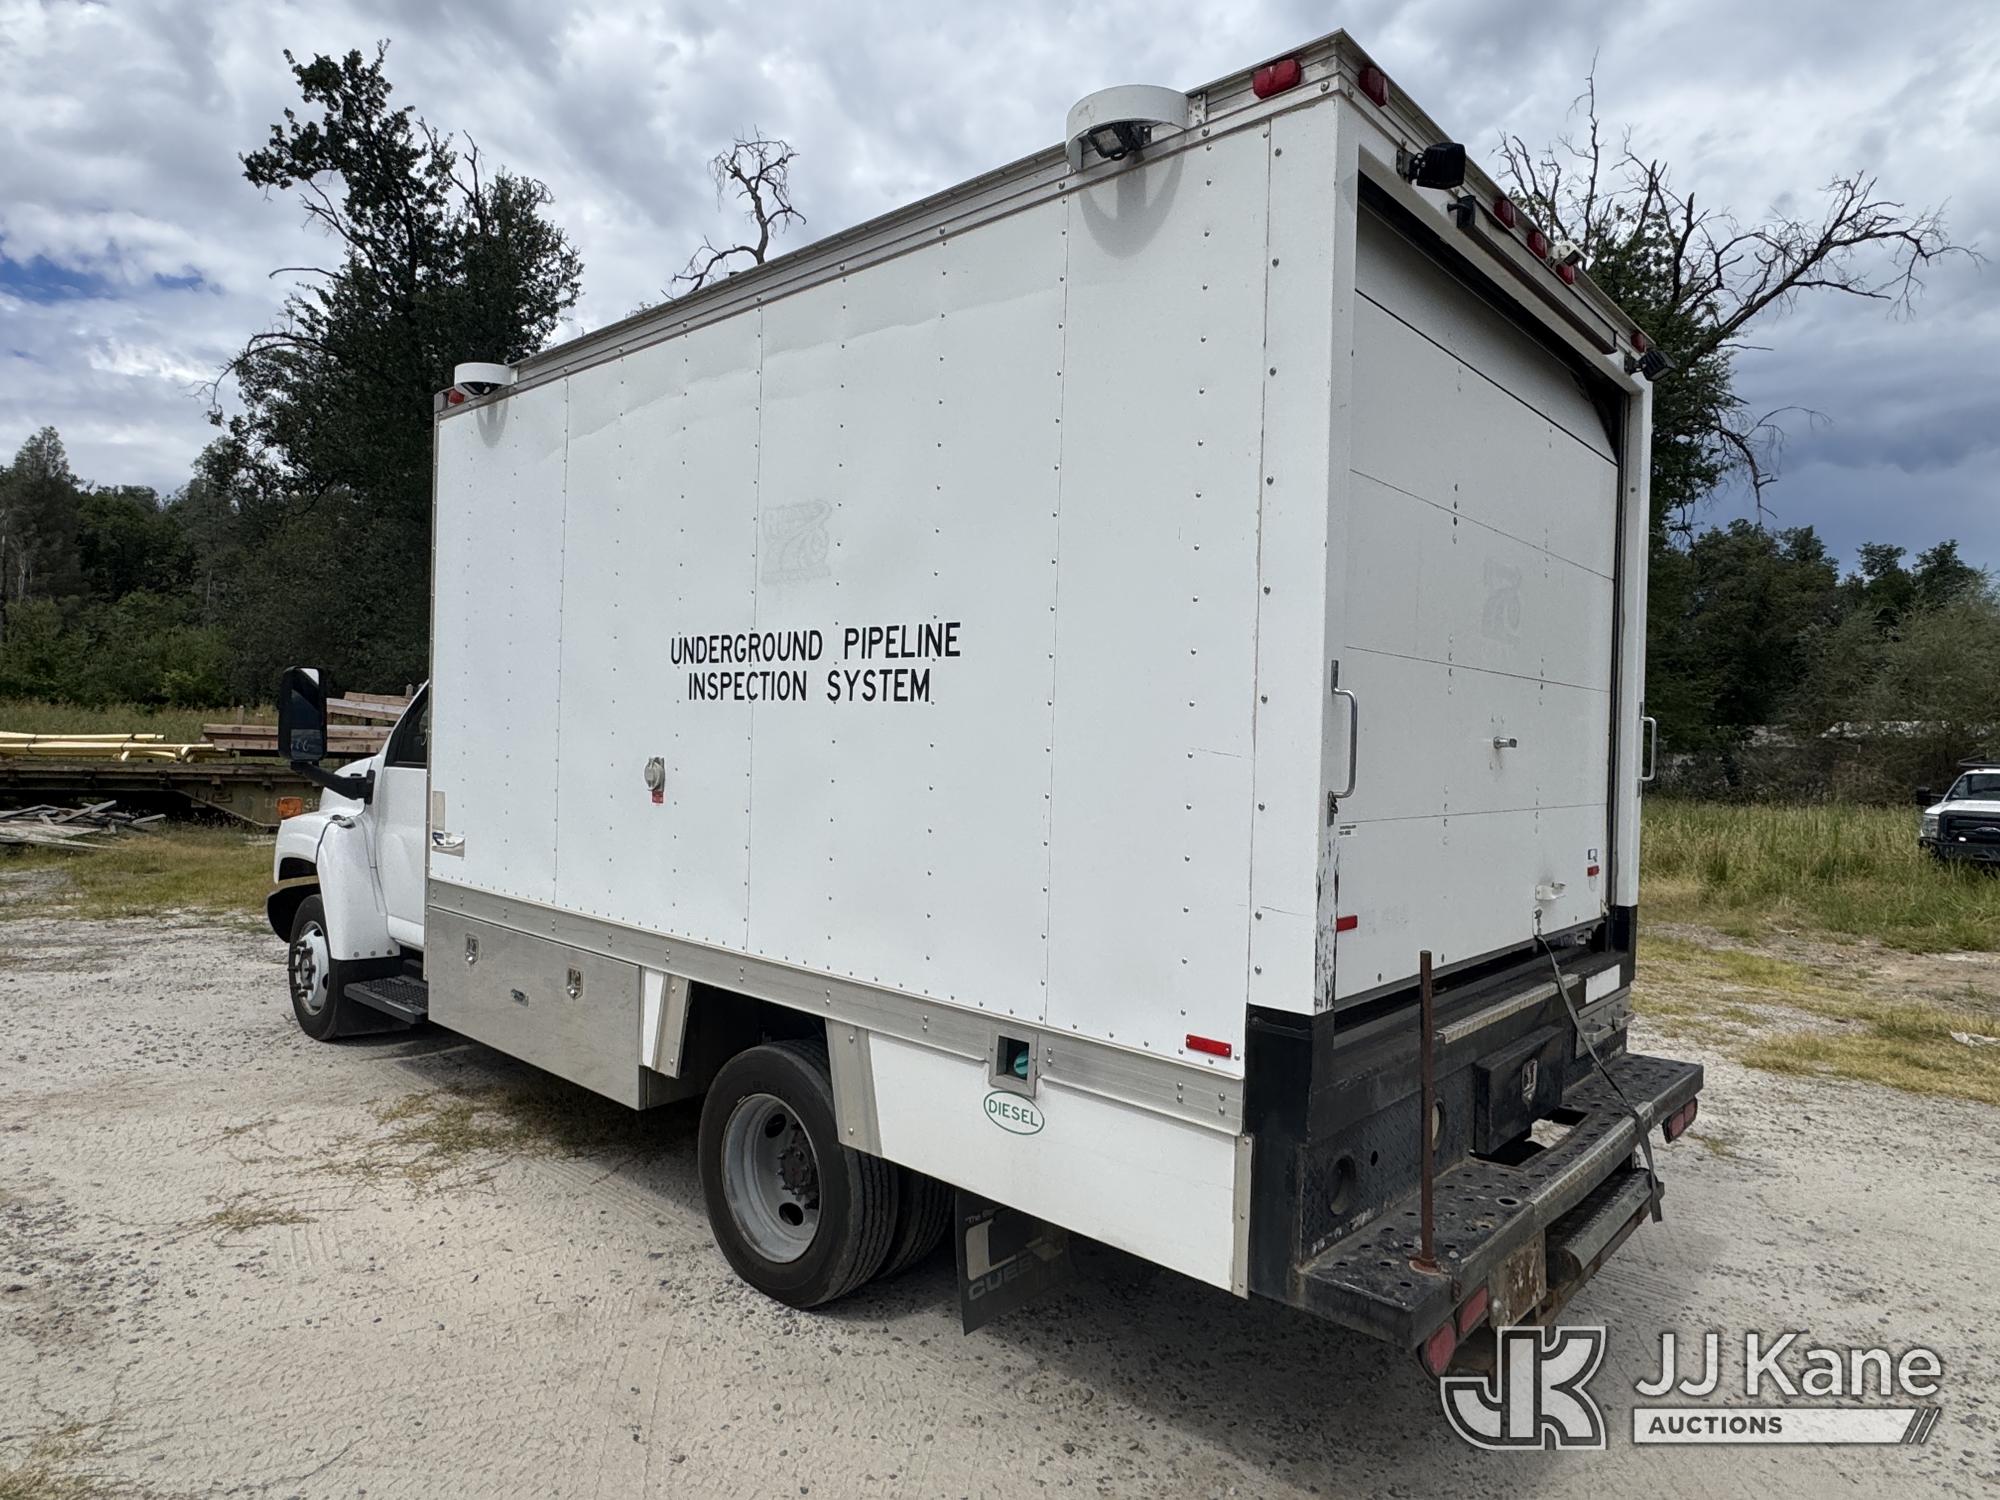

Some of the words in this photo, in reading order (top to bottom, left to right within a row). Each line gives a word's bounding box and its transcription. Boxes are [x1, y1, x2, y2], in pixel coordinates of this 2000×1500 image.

[671, 630, 823, 665] UNDERGROUND
[844, 622, 961, 660] PIPELINE
[688, 671, 807, 701] INSPECTION
[827, 668, 931, 702] SYSTEM
[988, 1099, 1039, 1127] DIESEL
